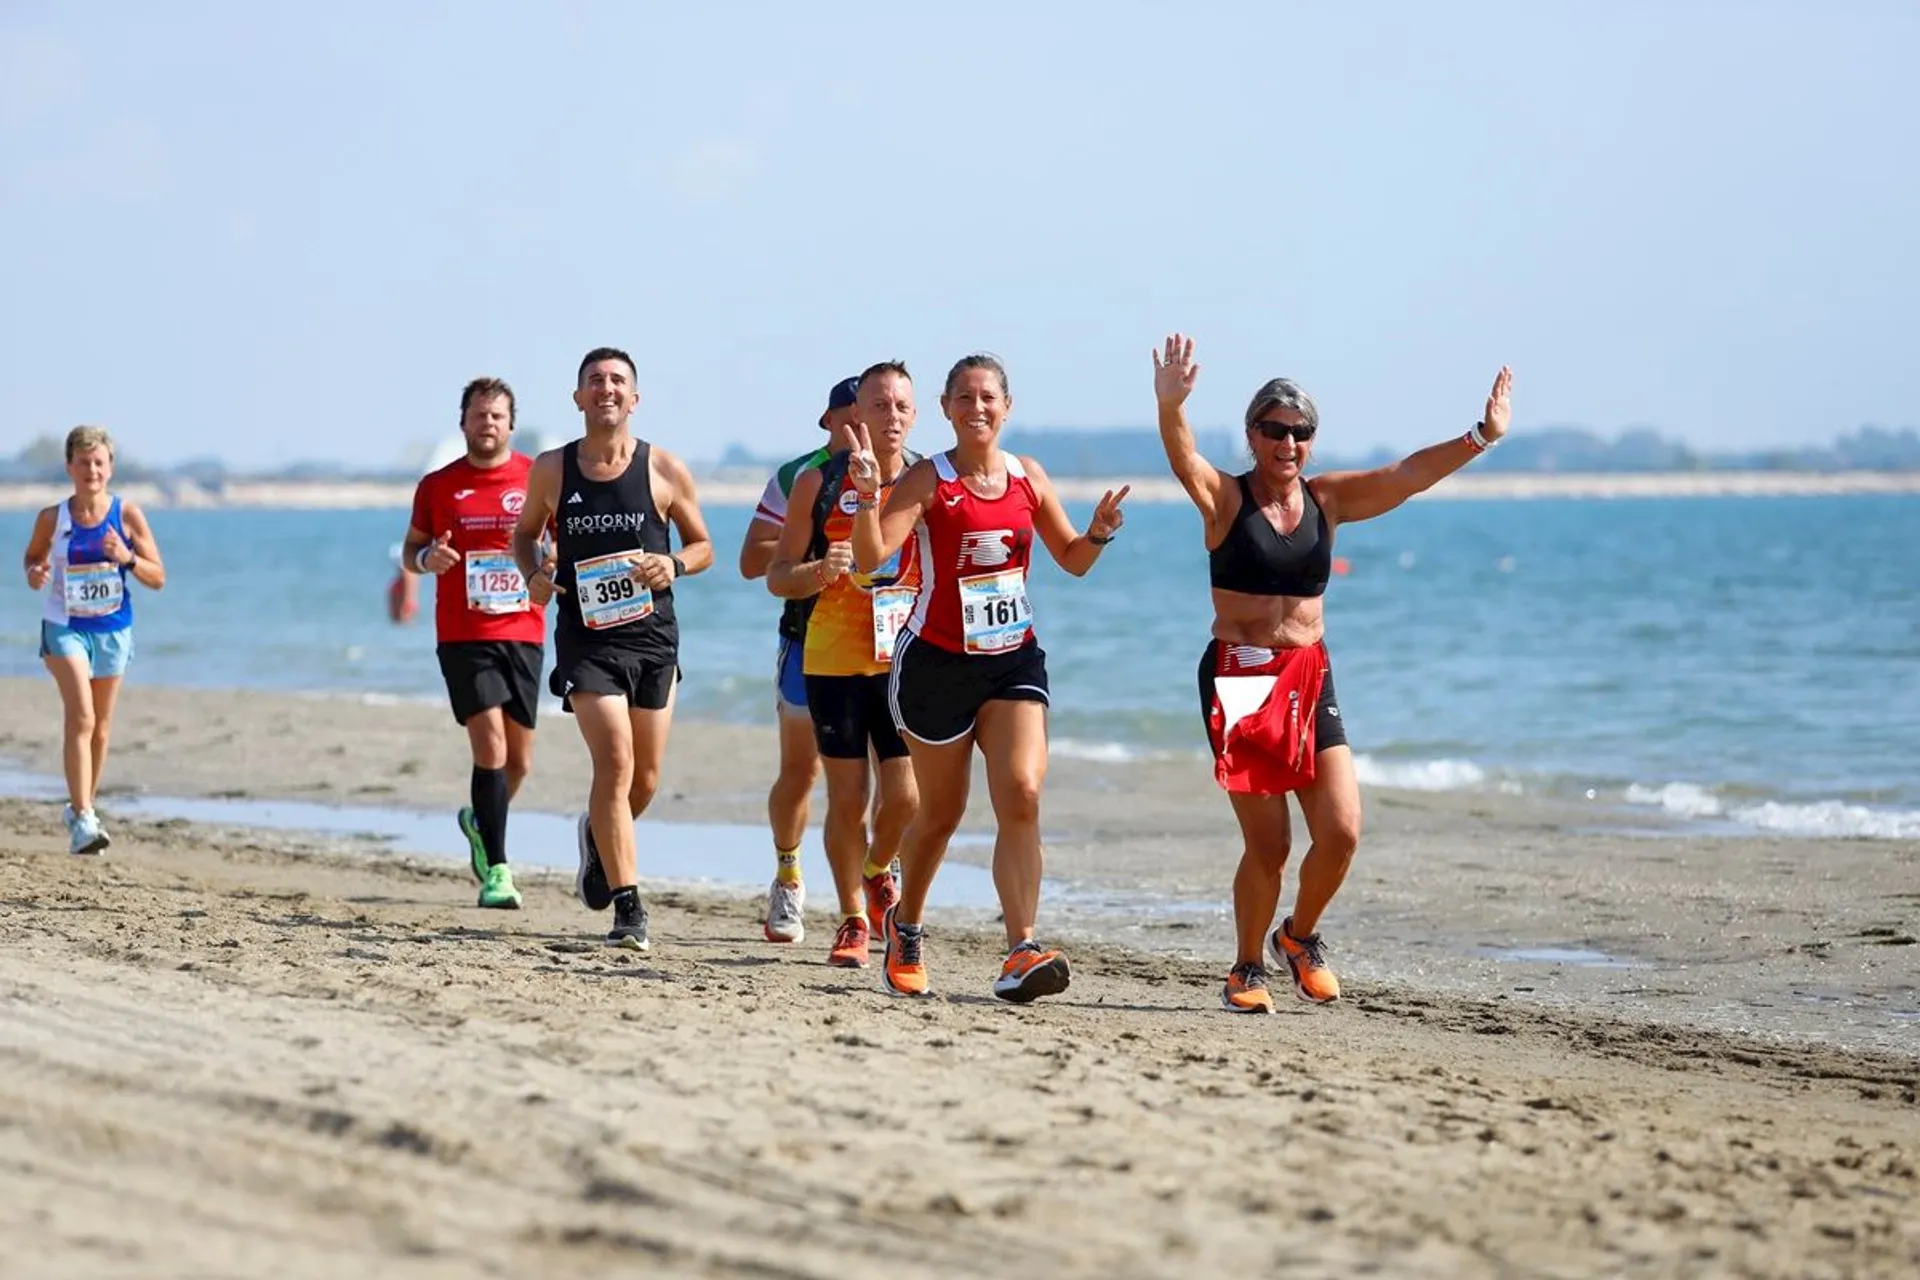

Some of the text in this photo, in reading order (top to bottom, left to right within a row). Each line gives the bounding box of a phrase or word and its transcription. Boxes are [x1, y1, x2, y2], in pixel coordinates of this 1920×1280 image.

[80, 584, 109, 601] 320
[480, 574, 519, 592] 1252
[595, 577, 634, 604] 399
[984, 598, 1019, 626] 161
